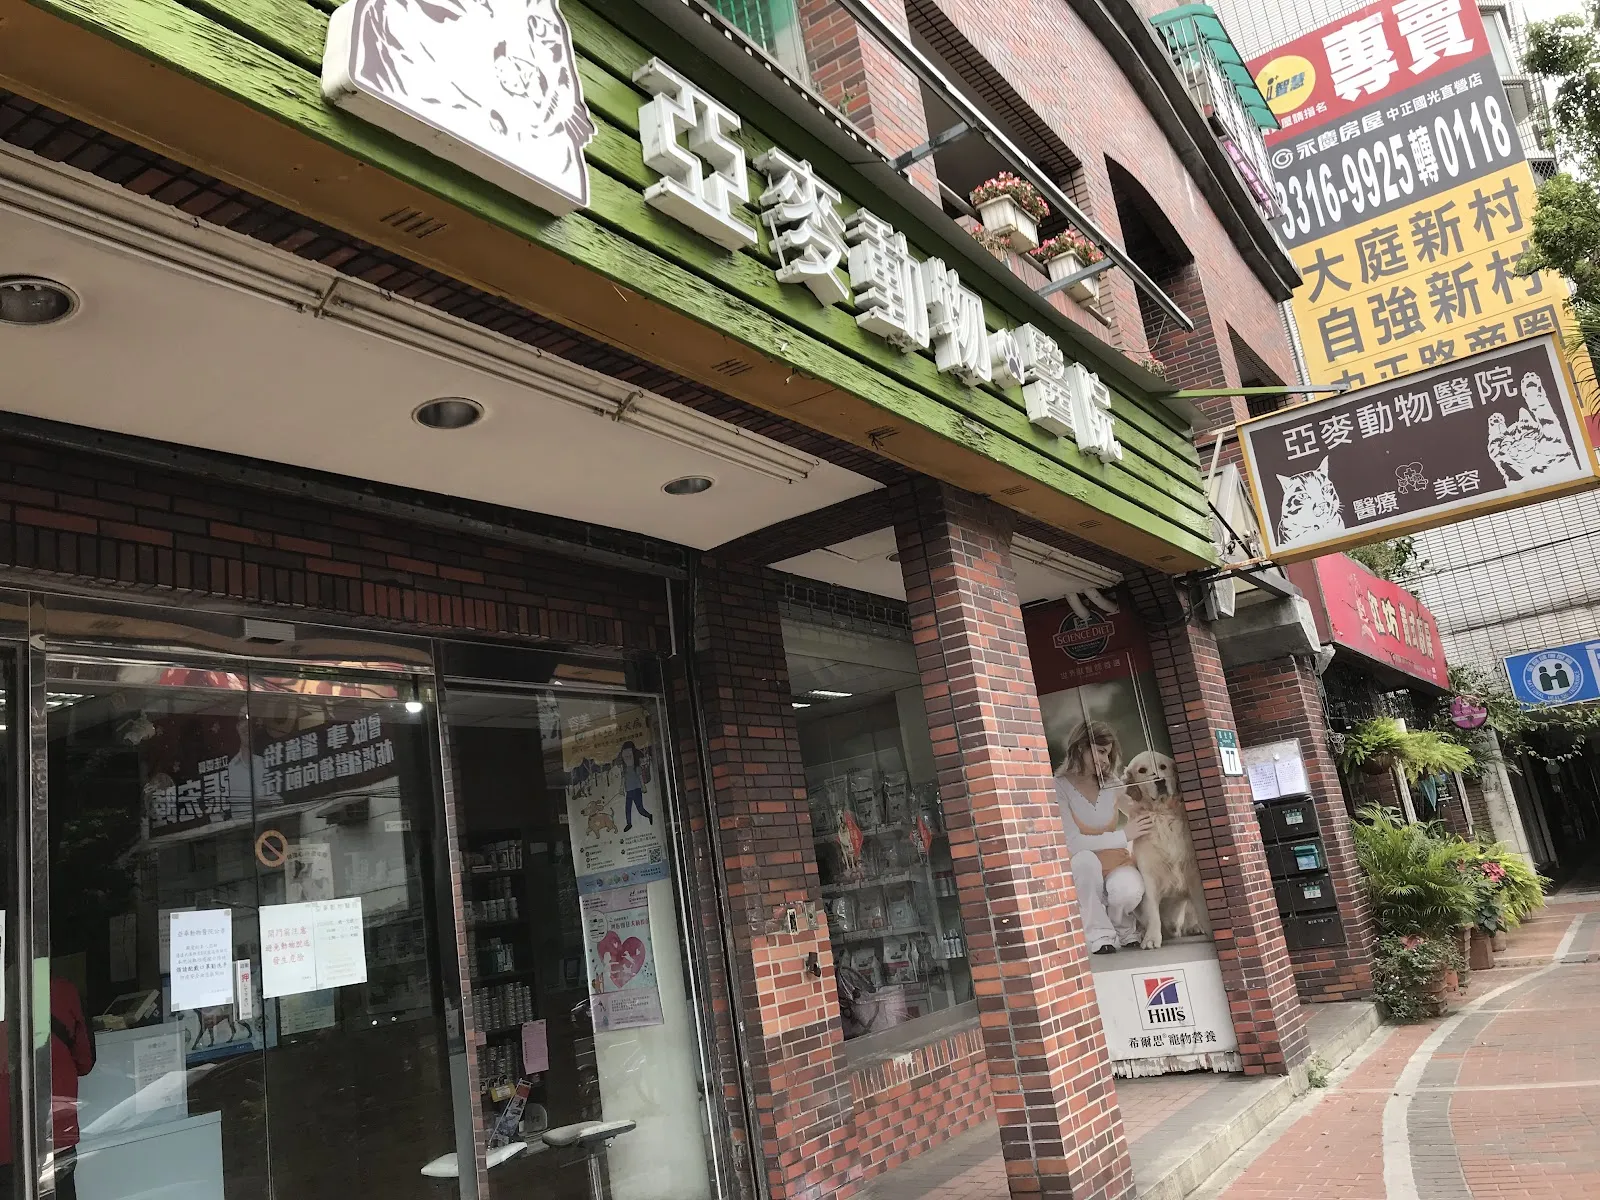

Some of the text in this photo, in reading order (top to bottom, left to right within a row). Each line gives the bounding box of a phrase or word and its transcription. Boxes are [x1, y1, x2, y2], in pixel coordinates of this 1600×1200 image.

[1321, 0, 1475, 102] 專賣
[1386, 72, 1484, 123] 中正國光直營店
[1296, 109, 1385, 161] 永慶房屋
[1301, 177, 1525, 304] 大庭新村
[1316, 239, 1545, 364] 自強新村
[1282, 365, 1519, 461] 亞麥動物醫院
[1352, 469, 1481, 521] 醫療 美容
[1056, 624, 1111, 645] SCIENCE DIET
[1147, 1006, 1186, 1023] Hill's
